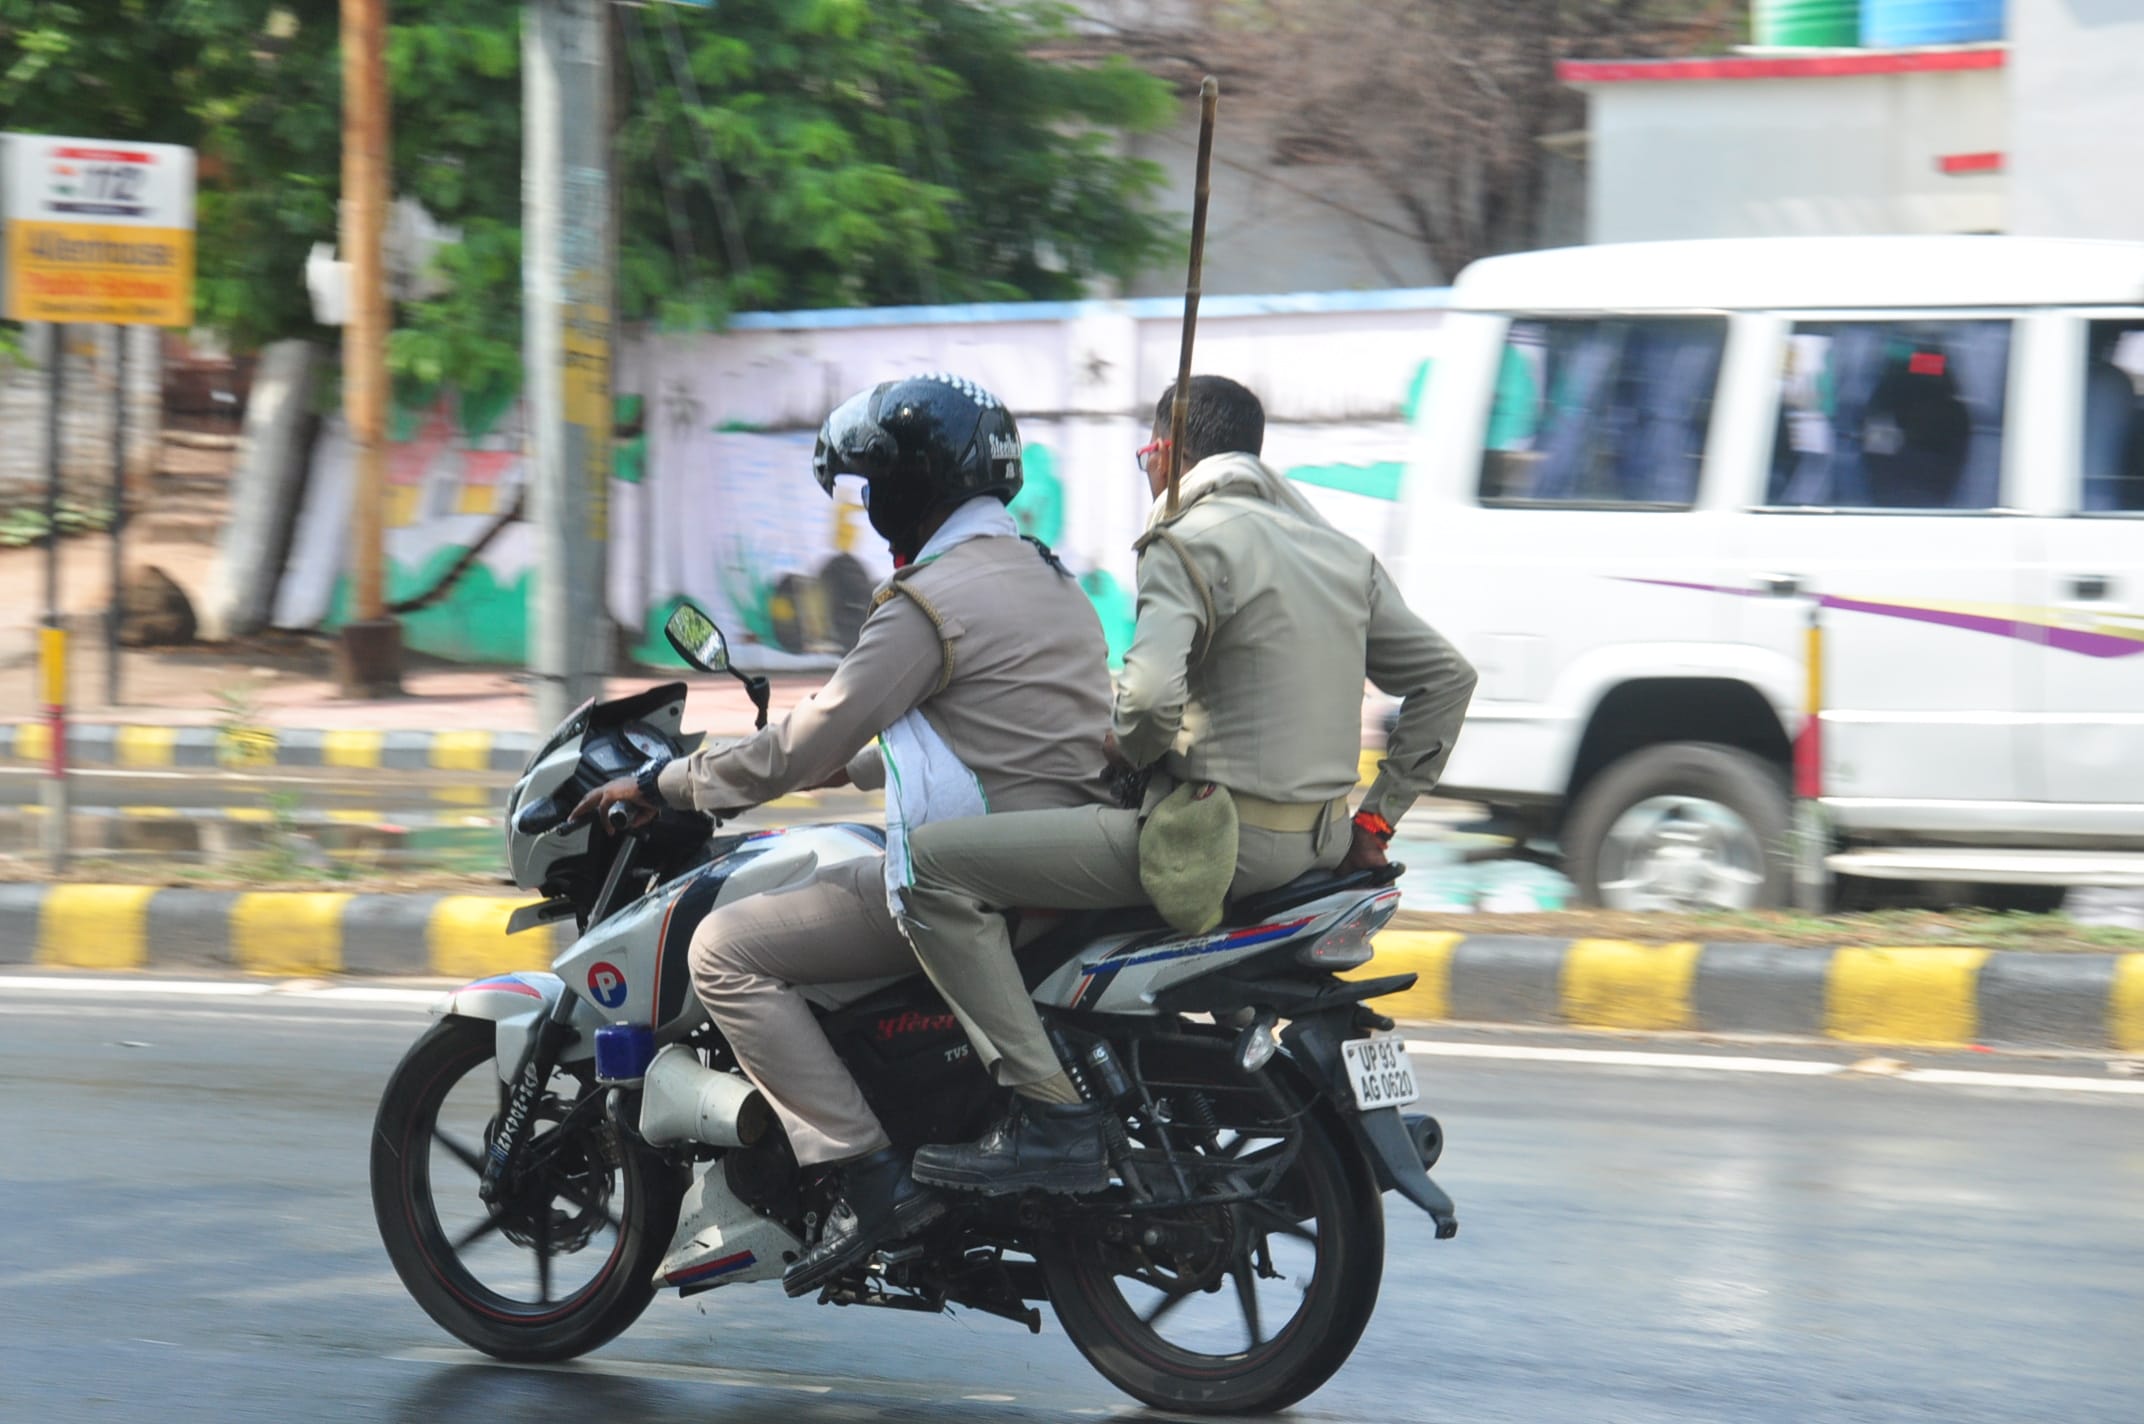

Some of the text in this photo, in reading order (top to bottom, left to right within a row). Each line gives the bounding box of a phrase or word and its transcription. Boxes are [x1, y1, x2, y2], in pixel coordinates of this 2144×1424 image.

[595, 971, 617, 1002] P
[944, 1044, 969, 1063] TVS
[1358, 1042, 1397, 1072] UP 93
[1361, 1070, 1414, 1102] AG 0620
